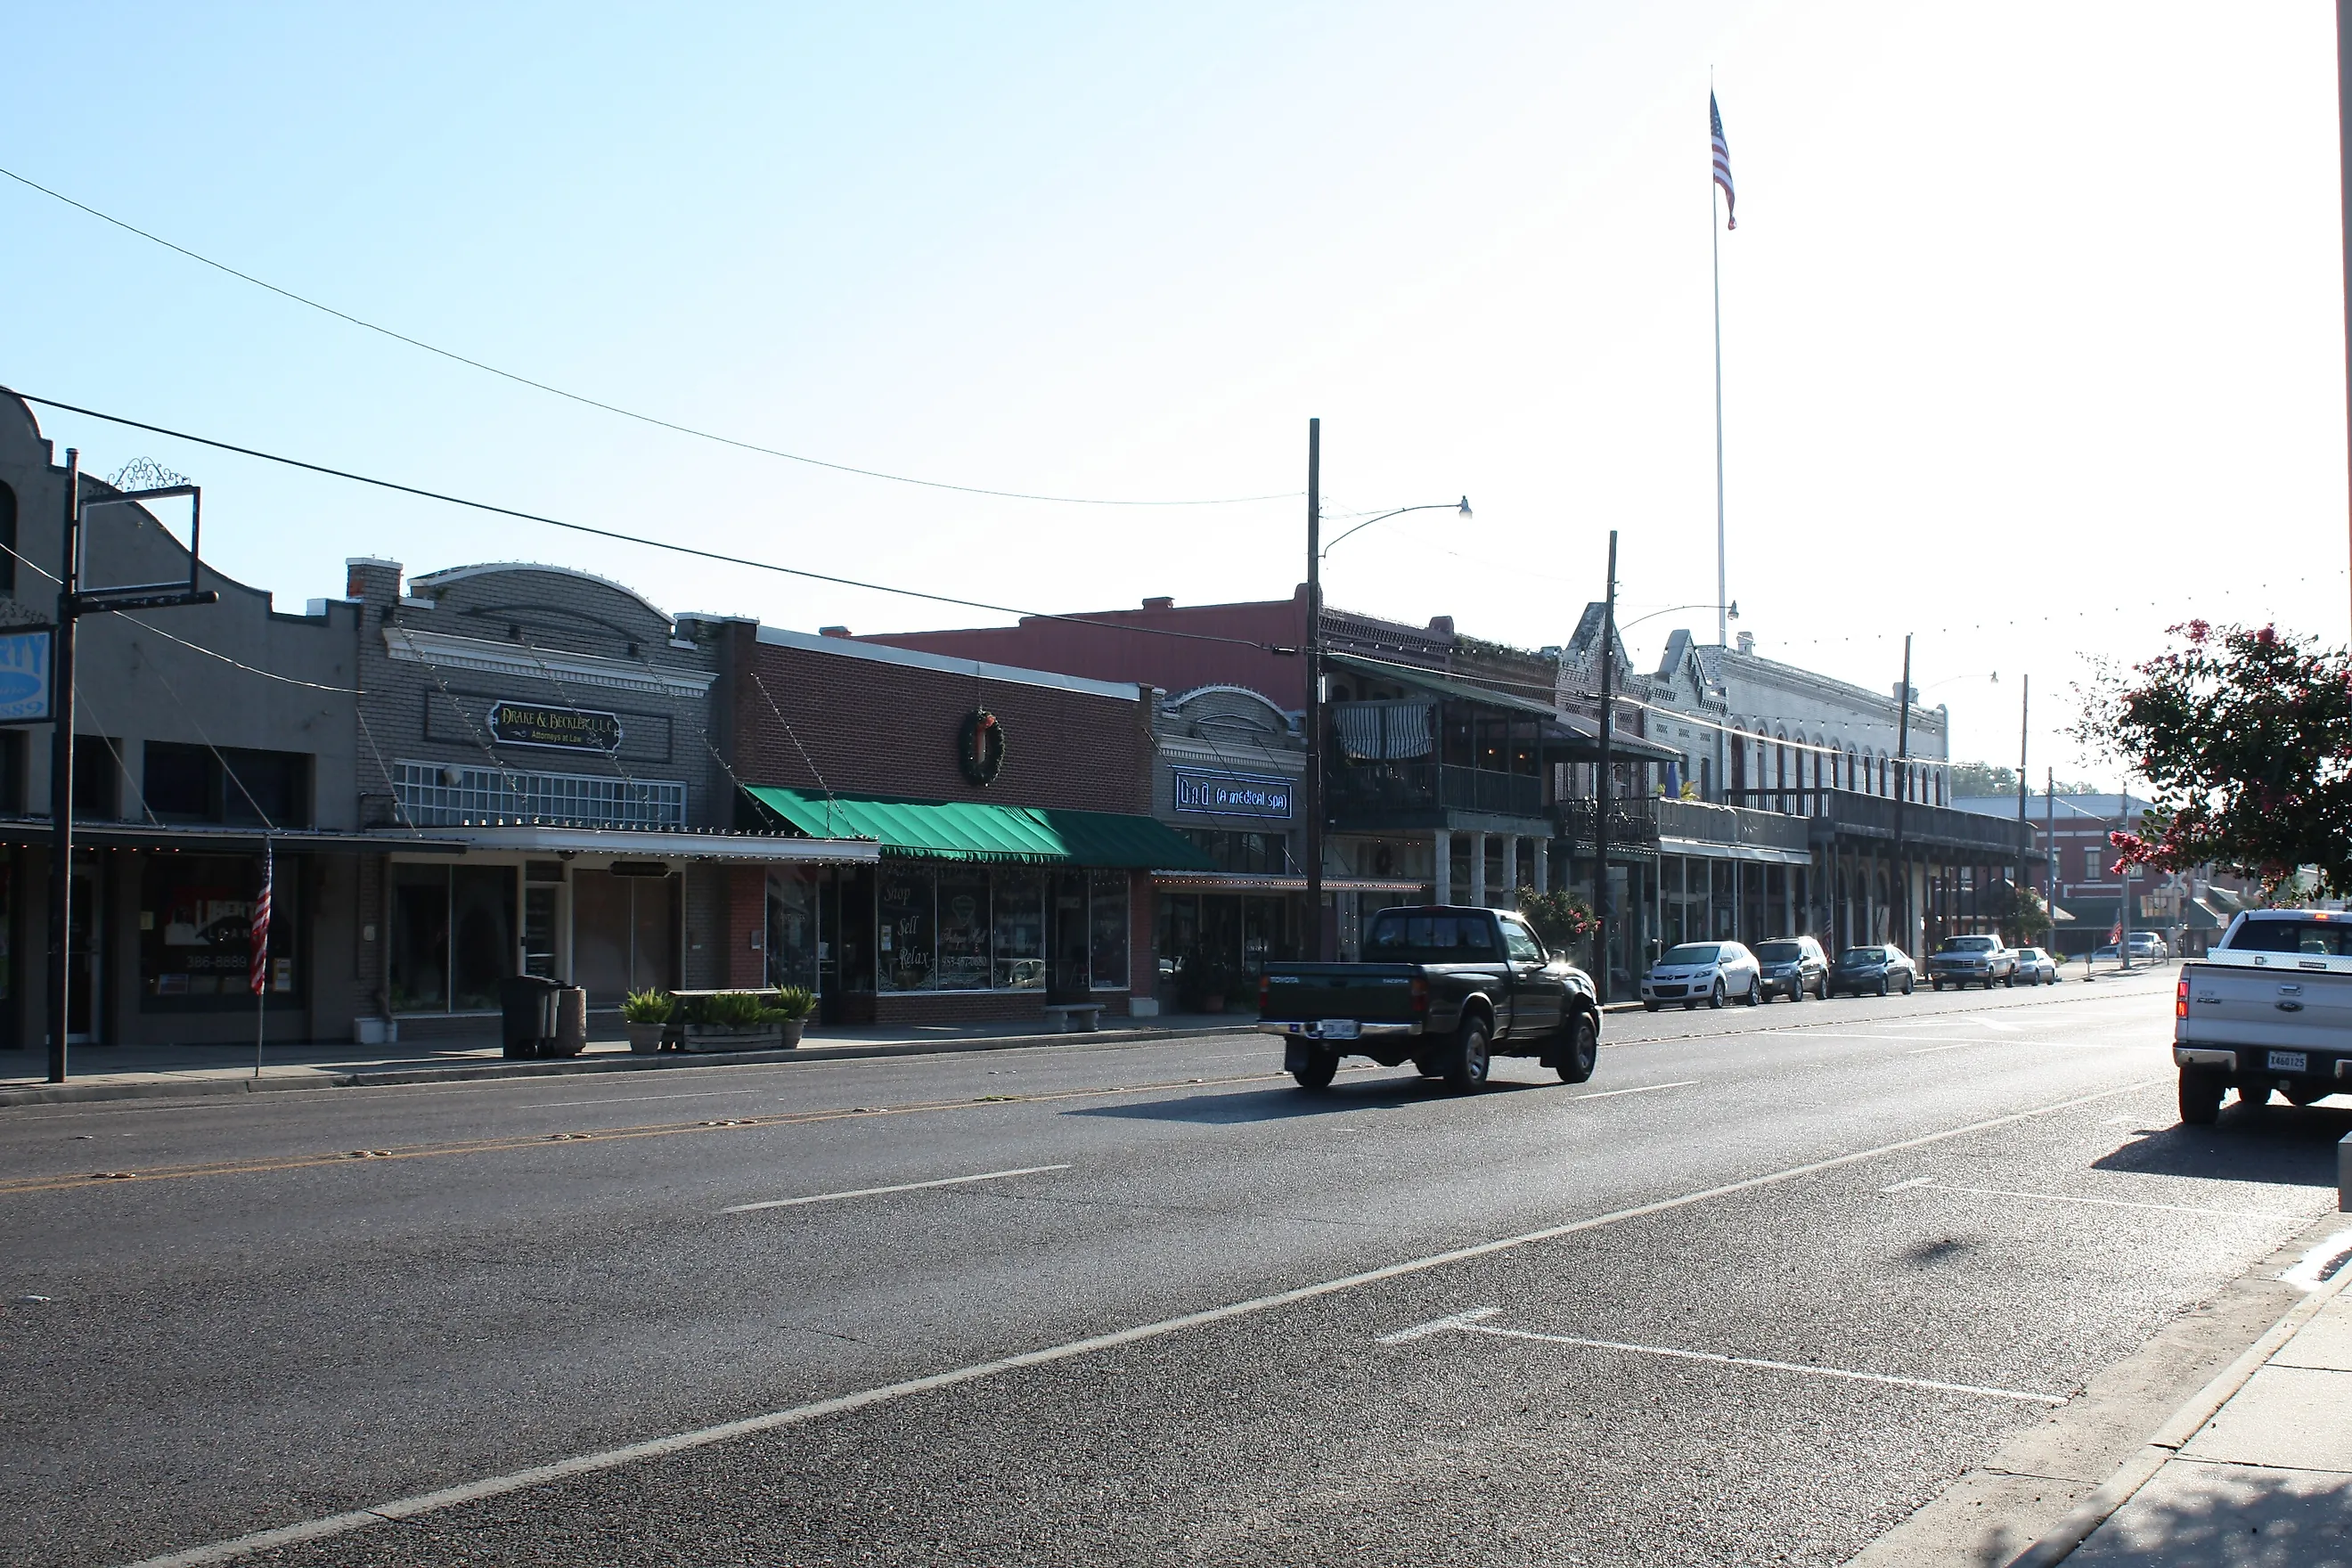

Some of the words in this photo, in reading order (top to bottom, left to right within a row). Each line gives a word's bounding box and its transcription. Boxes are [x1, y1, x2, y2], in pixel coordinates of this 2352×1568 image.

[536, 711, 547, 728] &
[531, 731, 561, 743] Attorneys
[562, 734, 568, 742] at
[569, 734, 582, 743] Law
[884, 880, 911, 905] Shop
[208, 927, 251, 940] LOAN
[897, 916, 919, 935] Sell
[186, 955, 247, 968] 386-8889
[899, 946, 931, 970] Relax
